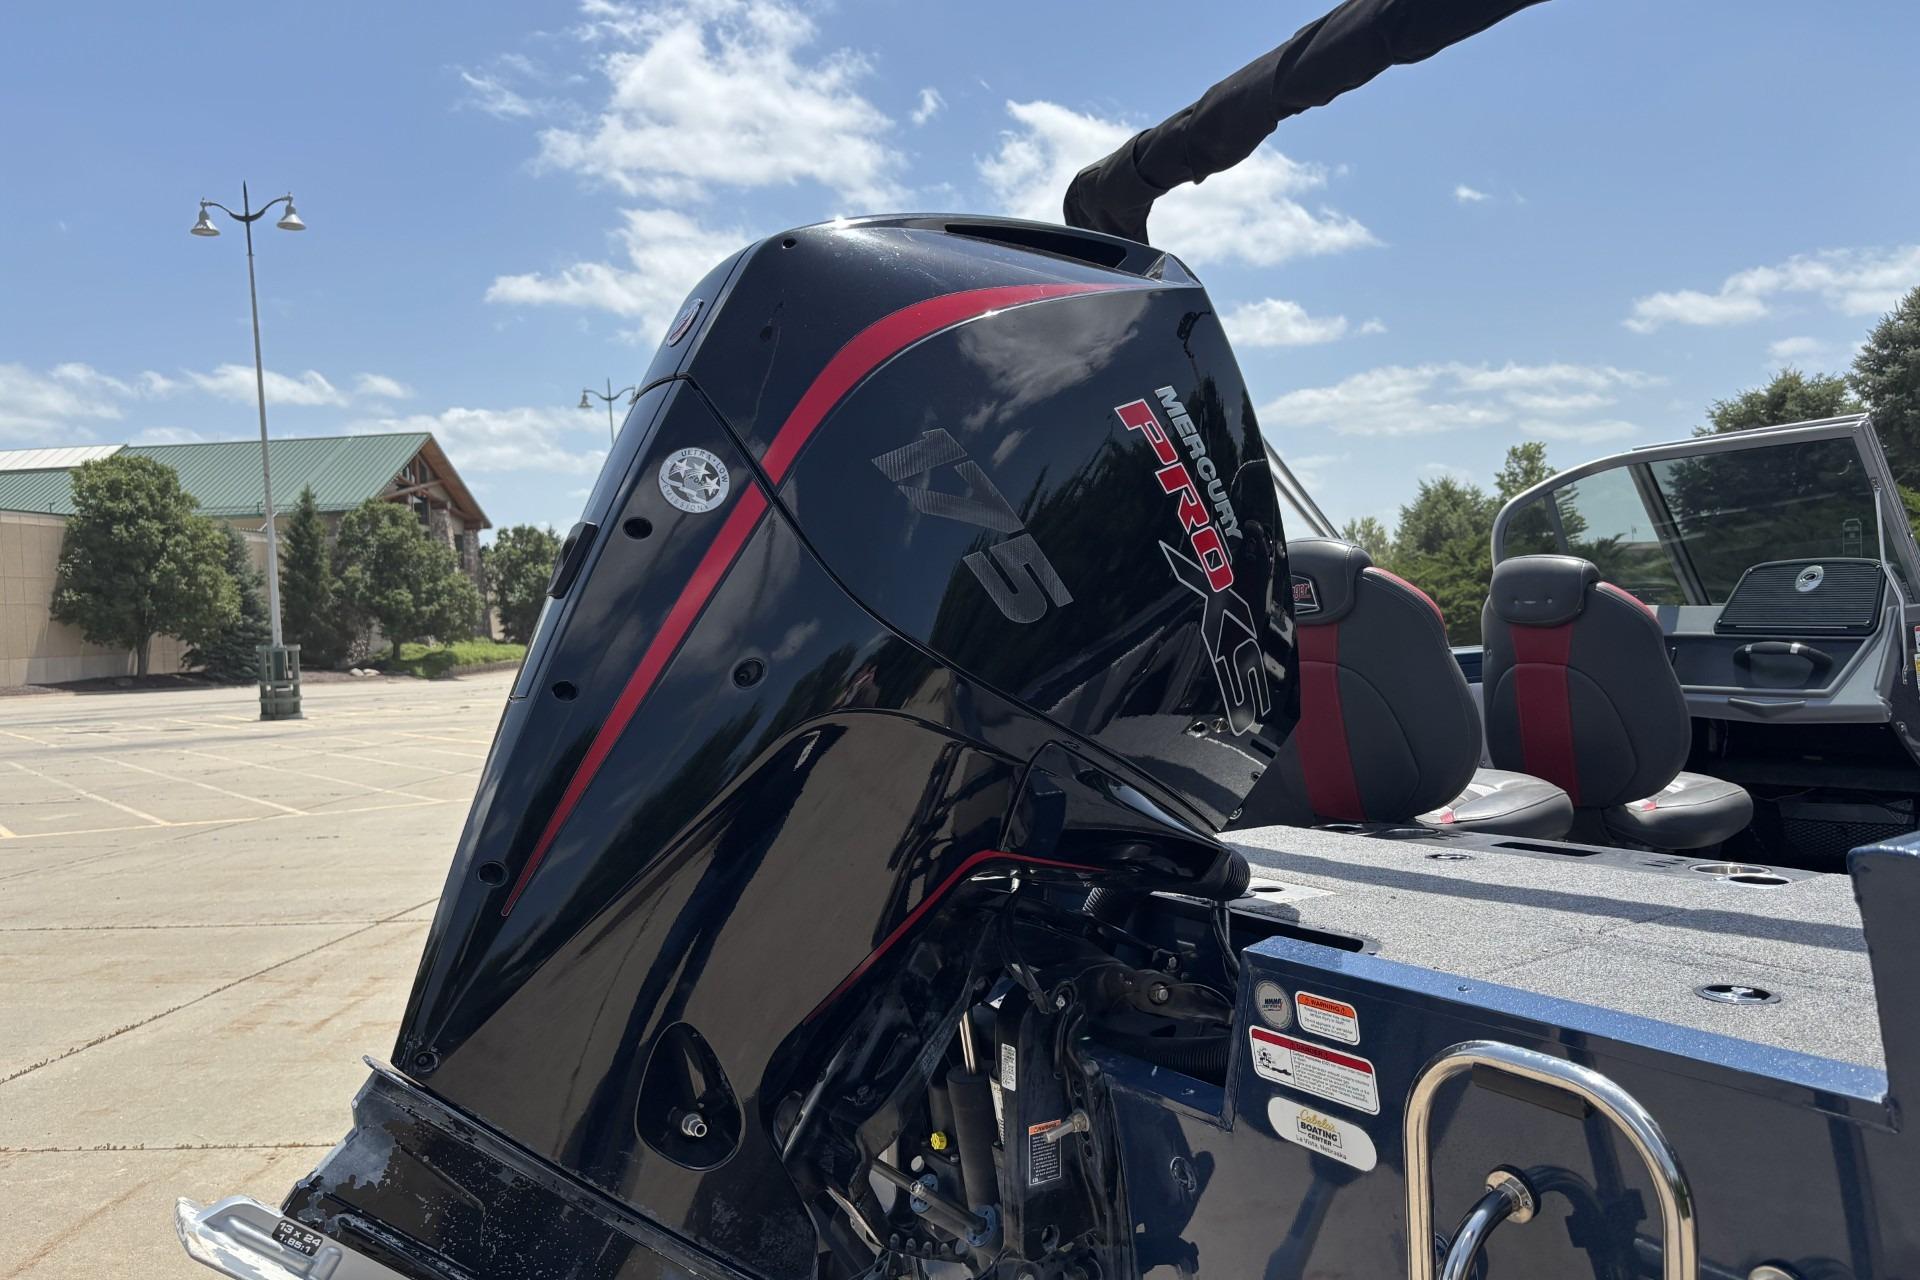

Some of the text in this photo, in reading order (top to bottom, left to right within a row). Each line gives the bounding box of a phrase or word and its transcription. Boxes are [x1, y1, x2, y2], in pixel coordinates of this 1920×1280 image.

[681, 449, 728, 483] ULTRA LOW
[1155, 385, 1243, 540] MERCURY
[1115, 398, 1234, 592] PRO
[871, 428, 1074, 623] 175
[1292, 583, 1310, 601] ger
[1158, 520, 1271, 736] XS
[1311, 999, 1339, 1013] WARNING
[1300, 1121, 1338, 1142] BOATING
[1307, 1133, 1332, 1147] CENTER
[279, 1233, 311, 1254] 1.85:1
[280, 1222, 322, 1247] 13 x 24
